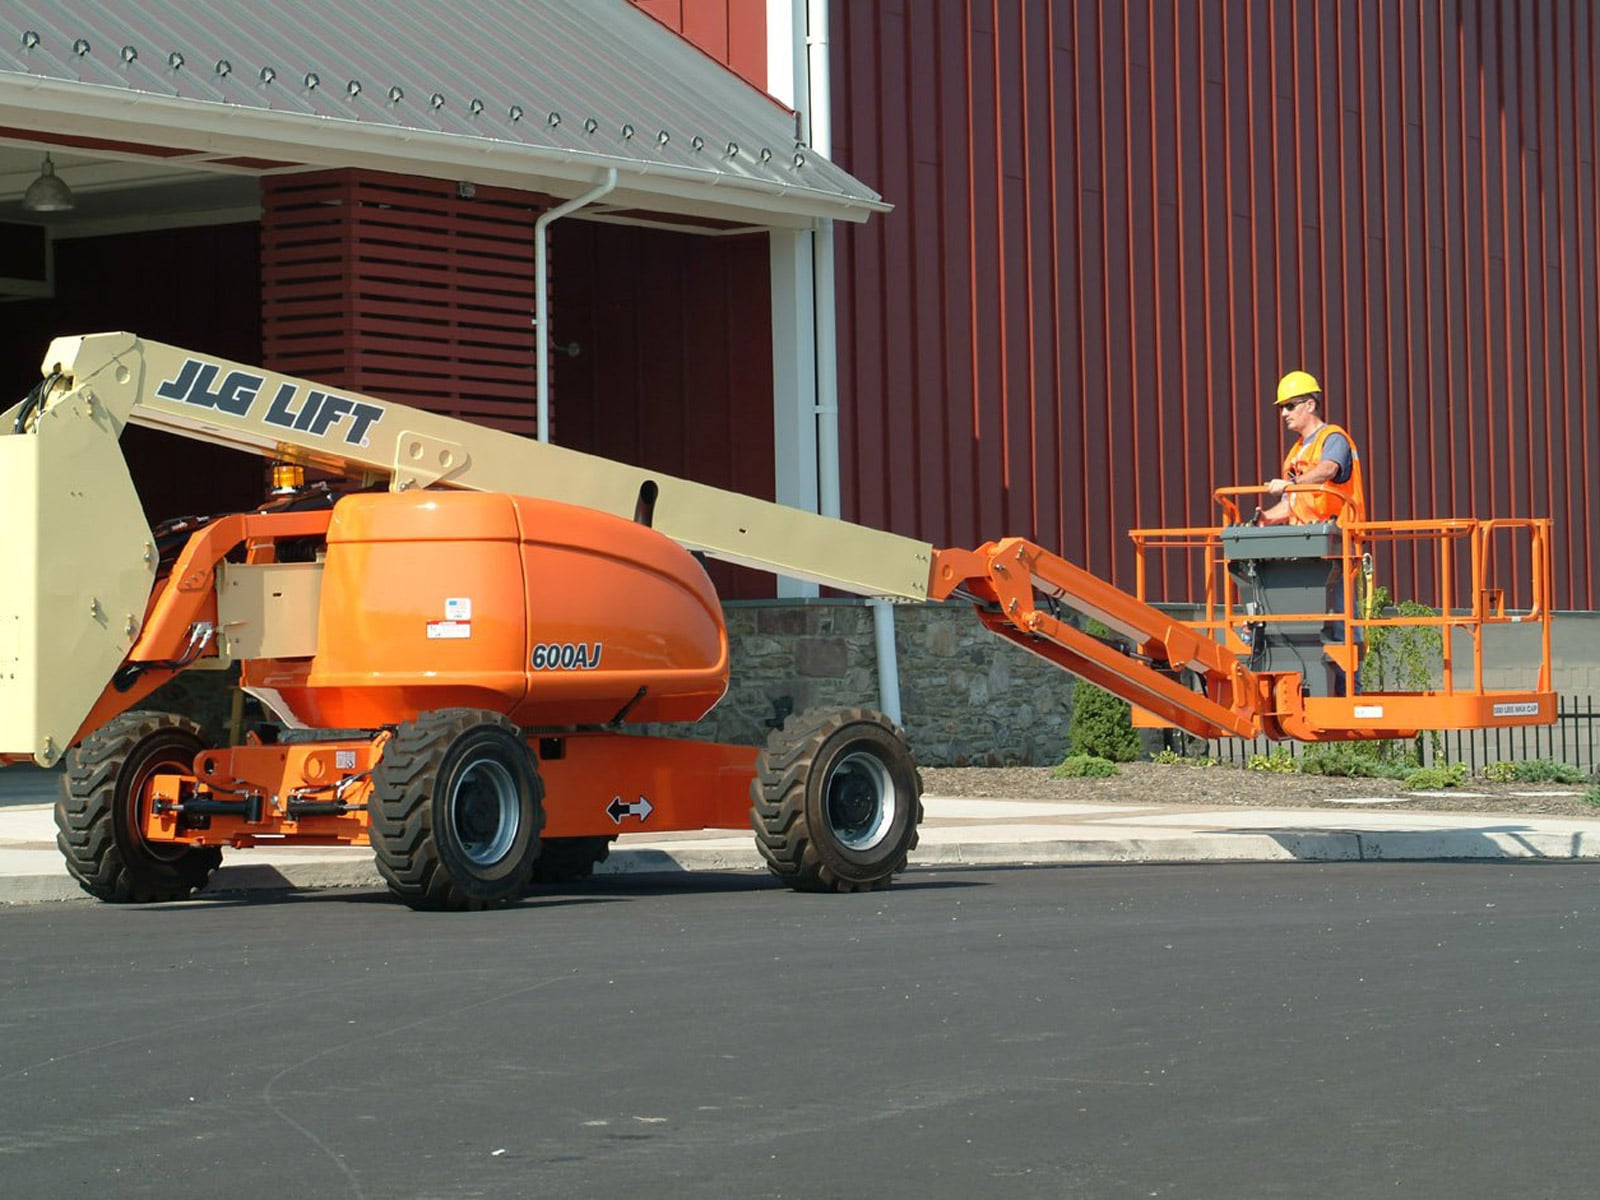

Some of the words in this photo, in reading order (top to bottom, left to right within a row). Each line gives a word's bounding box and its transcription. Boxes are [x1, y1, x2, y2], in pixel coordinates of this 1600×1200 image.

[155, 358, 266, 418] JLG
[264, 383, 385, 446] LIFT
[532, 643, 602, 670] 600AJ
